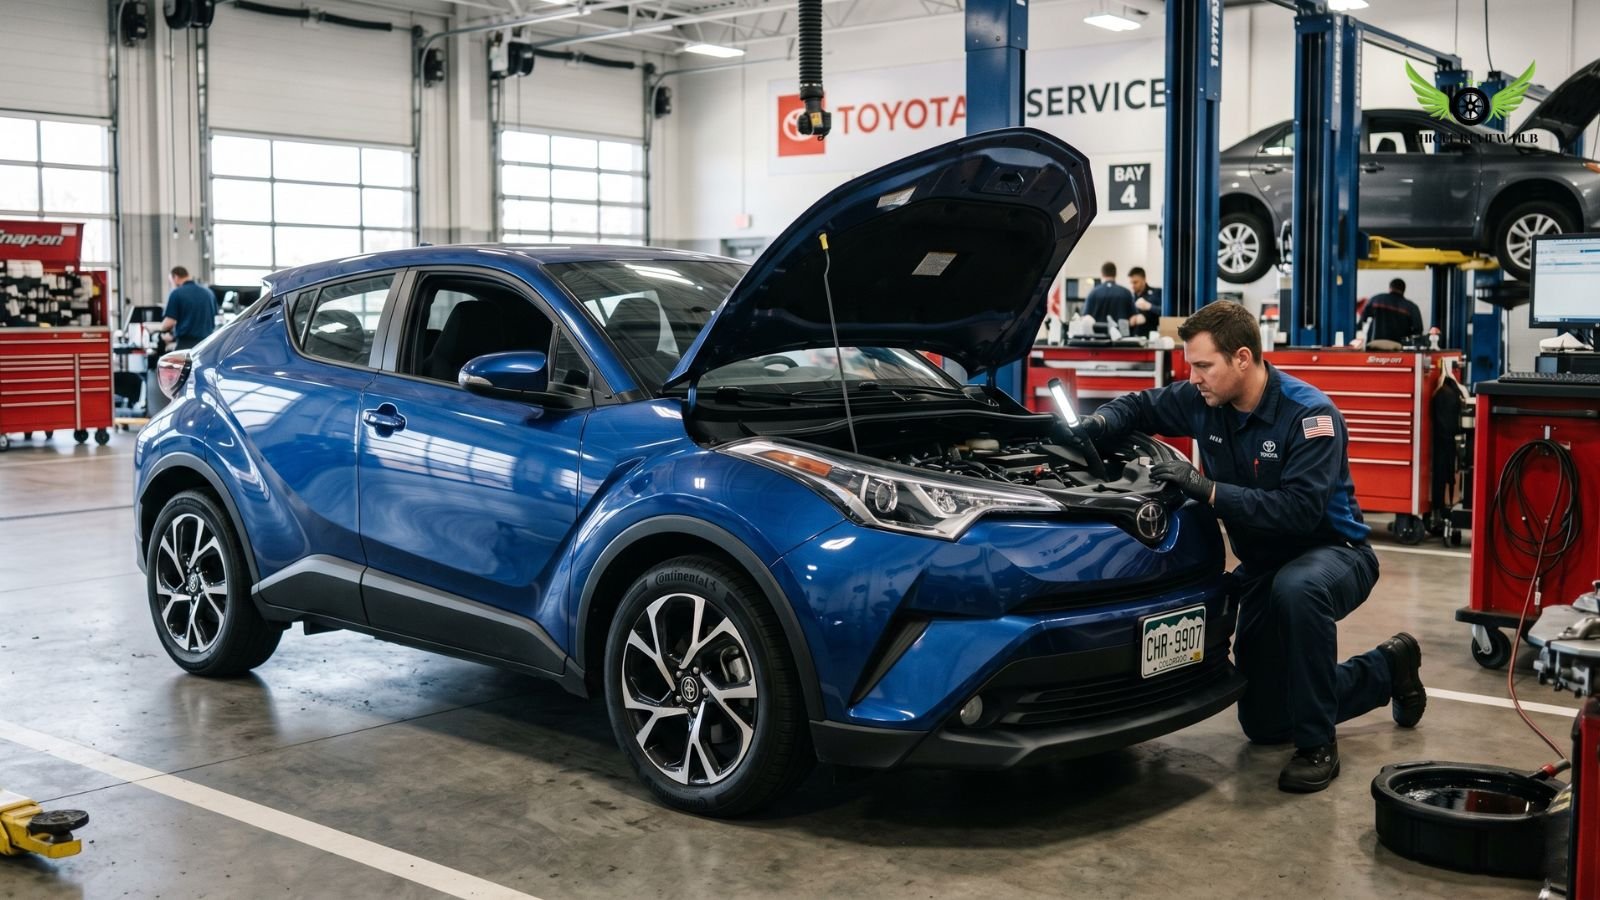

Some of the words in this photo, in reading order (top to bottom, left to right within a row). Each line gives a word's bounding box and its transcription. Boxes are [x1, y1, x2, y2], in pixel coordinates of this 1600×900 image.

[837, 95, 966, 135] TOYOTA
[1026, 78, 1165, 118] SERVICE
[1114, 166, 1145, 182] BAY
[1120, 184, 1138, 208] 4
[655, 570, 709, 589] Continental
